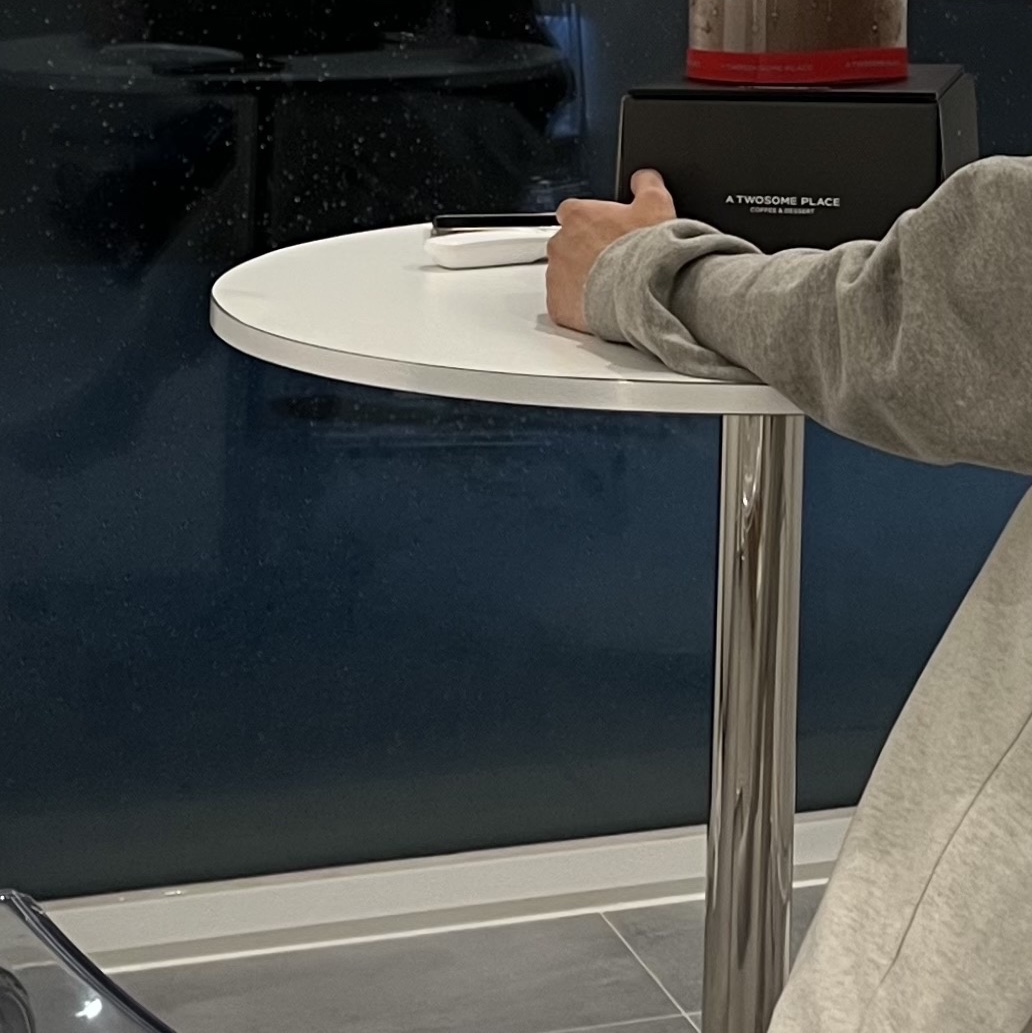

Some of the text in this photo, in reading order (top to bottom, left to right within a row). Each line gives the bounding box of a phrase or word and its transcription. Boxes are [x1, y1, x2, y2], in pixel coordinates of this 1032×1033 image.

[725, 195, 840, 207] A TWOSOME PLACE
[750, 206, 777, 214] COFFEE
